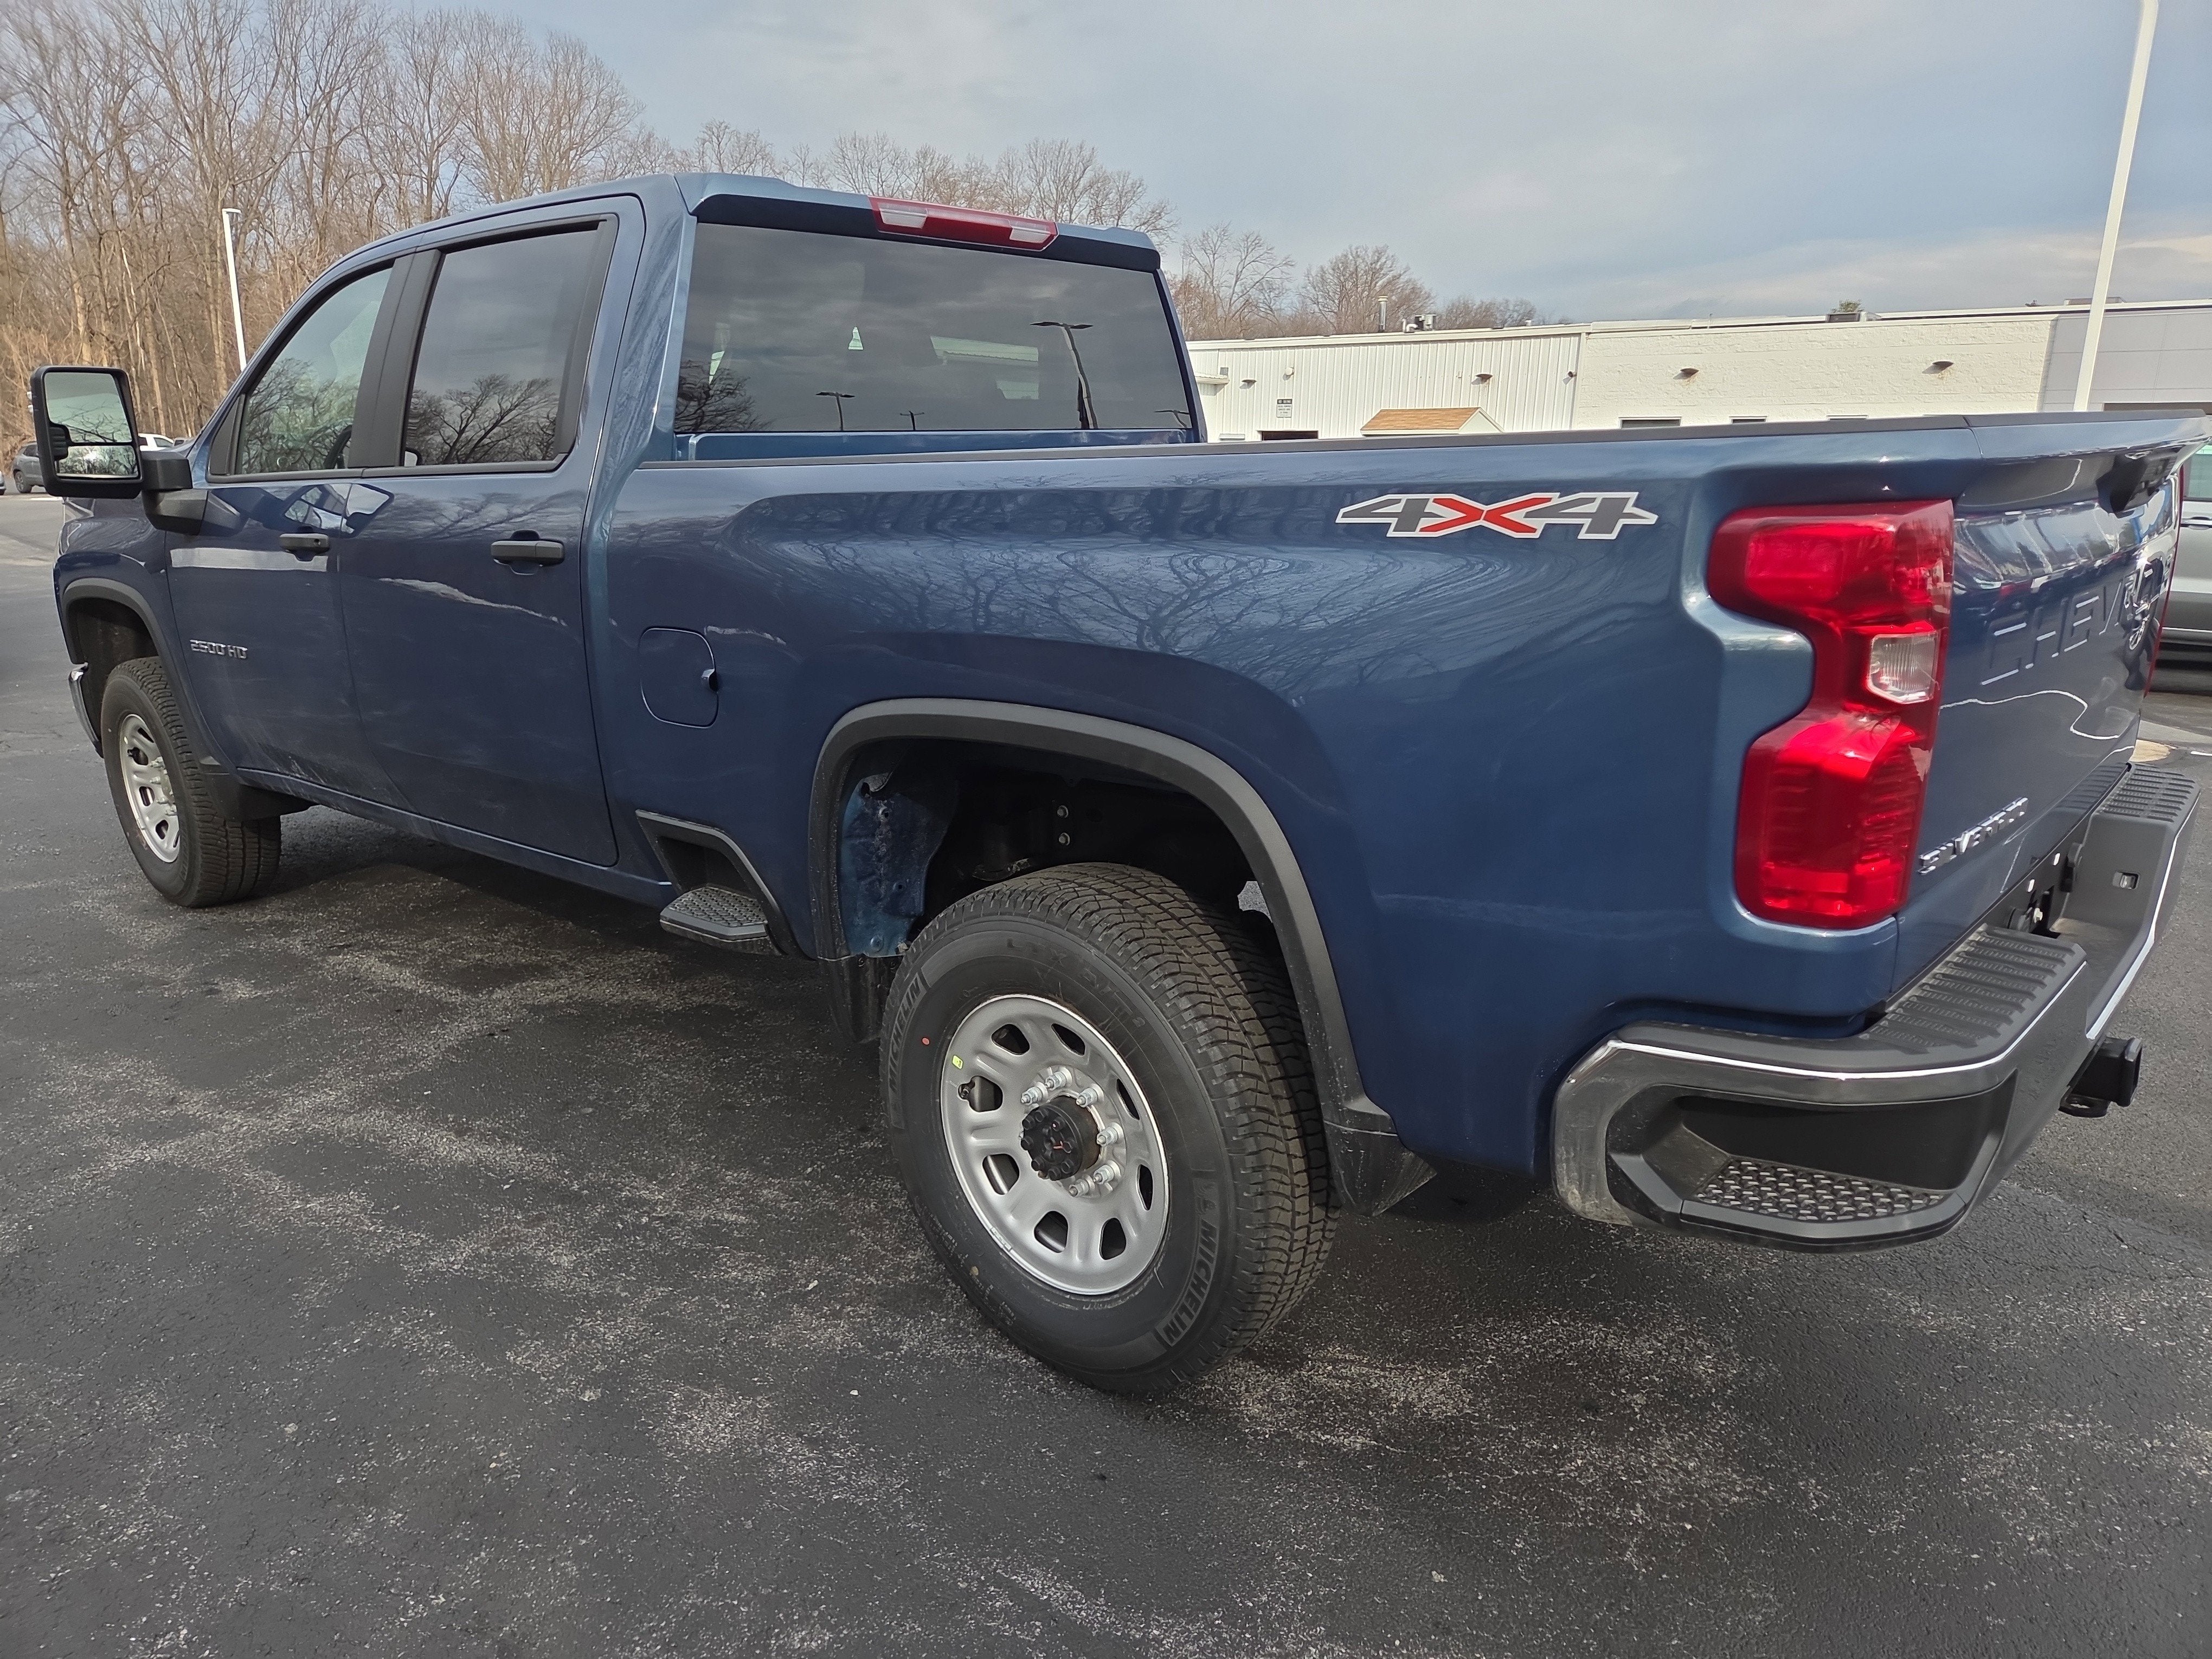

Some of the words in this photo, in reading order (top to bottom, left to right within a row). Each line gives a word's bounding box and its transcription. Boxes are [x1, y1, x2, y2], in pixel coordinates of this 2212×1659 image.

[190, 639, 226, 655] 2500
[227, 645, 248, 659] HD
[889, 974, 923, 1093] MICHELIN
[1163, 1219, 1218, 1346] MICHELIN
